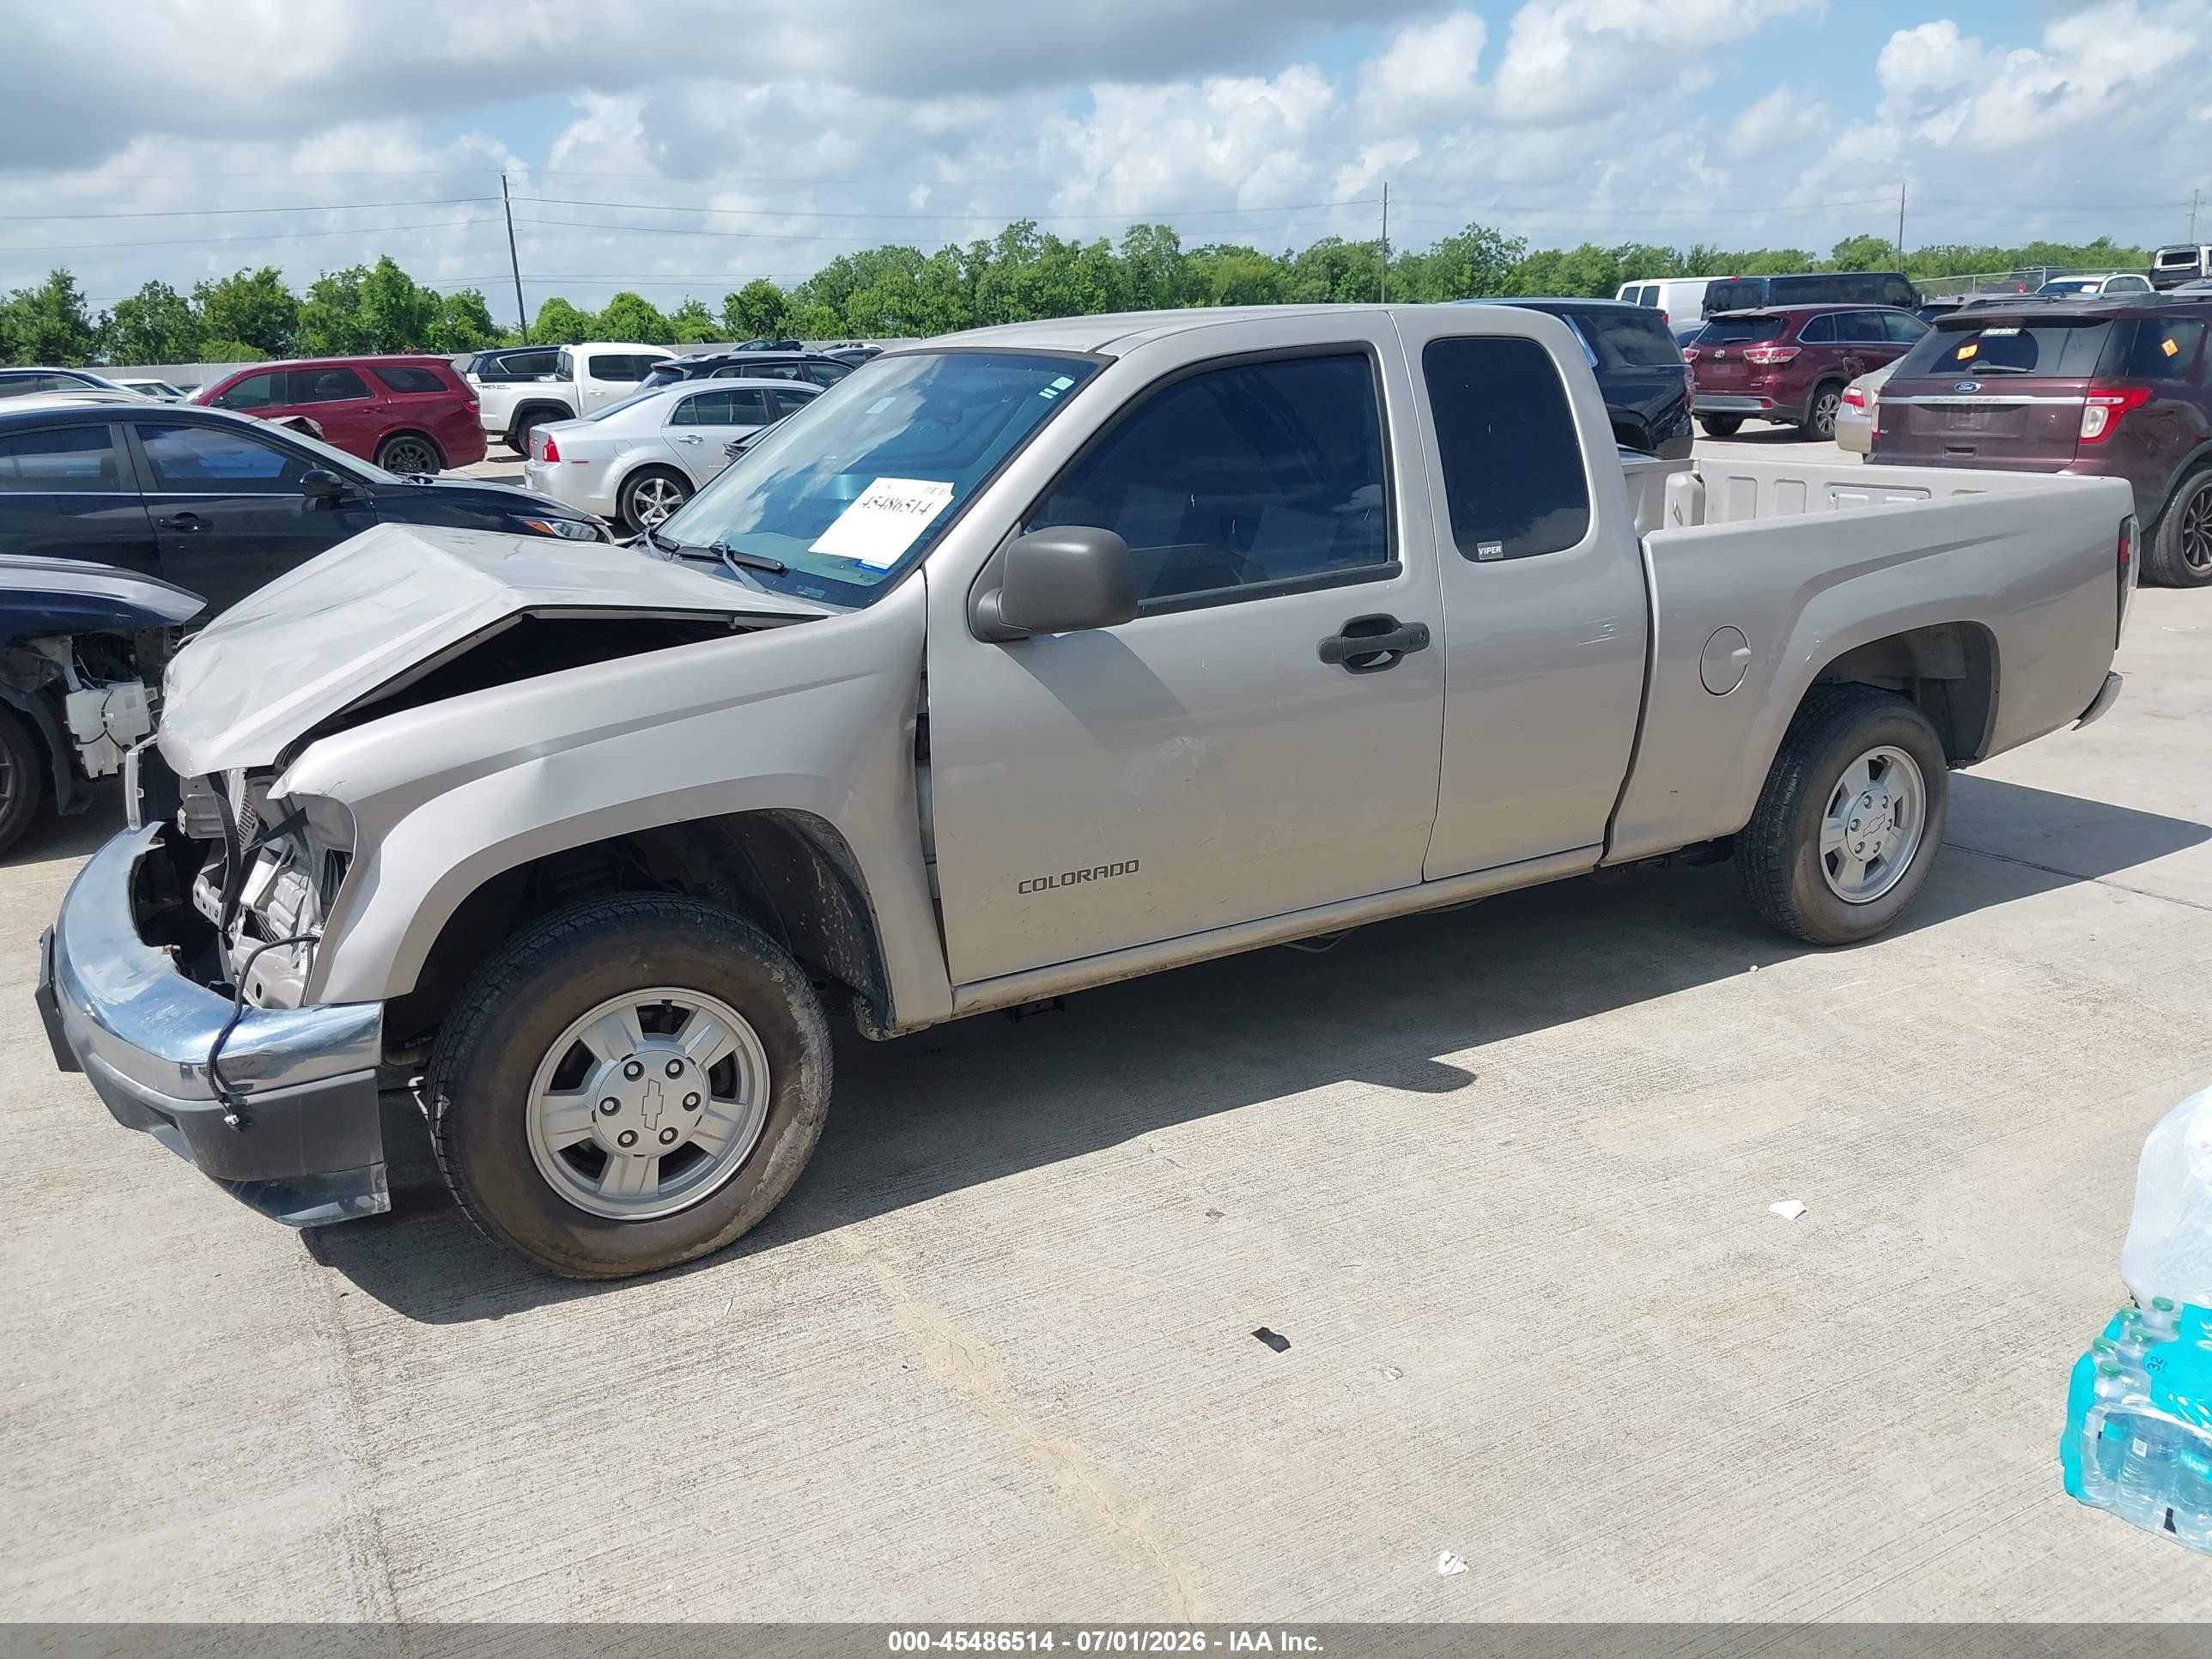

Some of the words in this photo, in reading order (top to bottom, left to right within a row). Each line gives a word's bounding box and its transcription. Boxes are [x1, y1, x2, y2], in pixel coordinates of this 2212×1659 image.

[862, 495, 934, 515] 45486514
[1478, 545, 1501, 556] VIPER
[1018, 860, 1140, 895] COLORADO
[2147, 1356, 2164, 1372] 32
